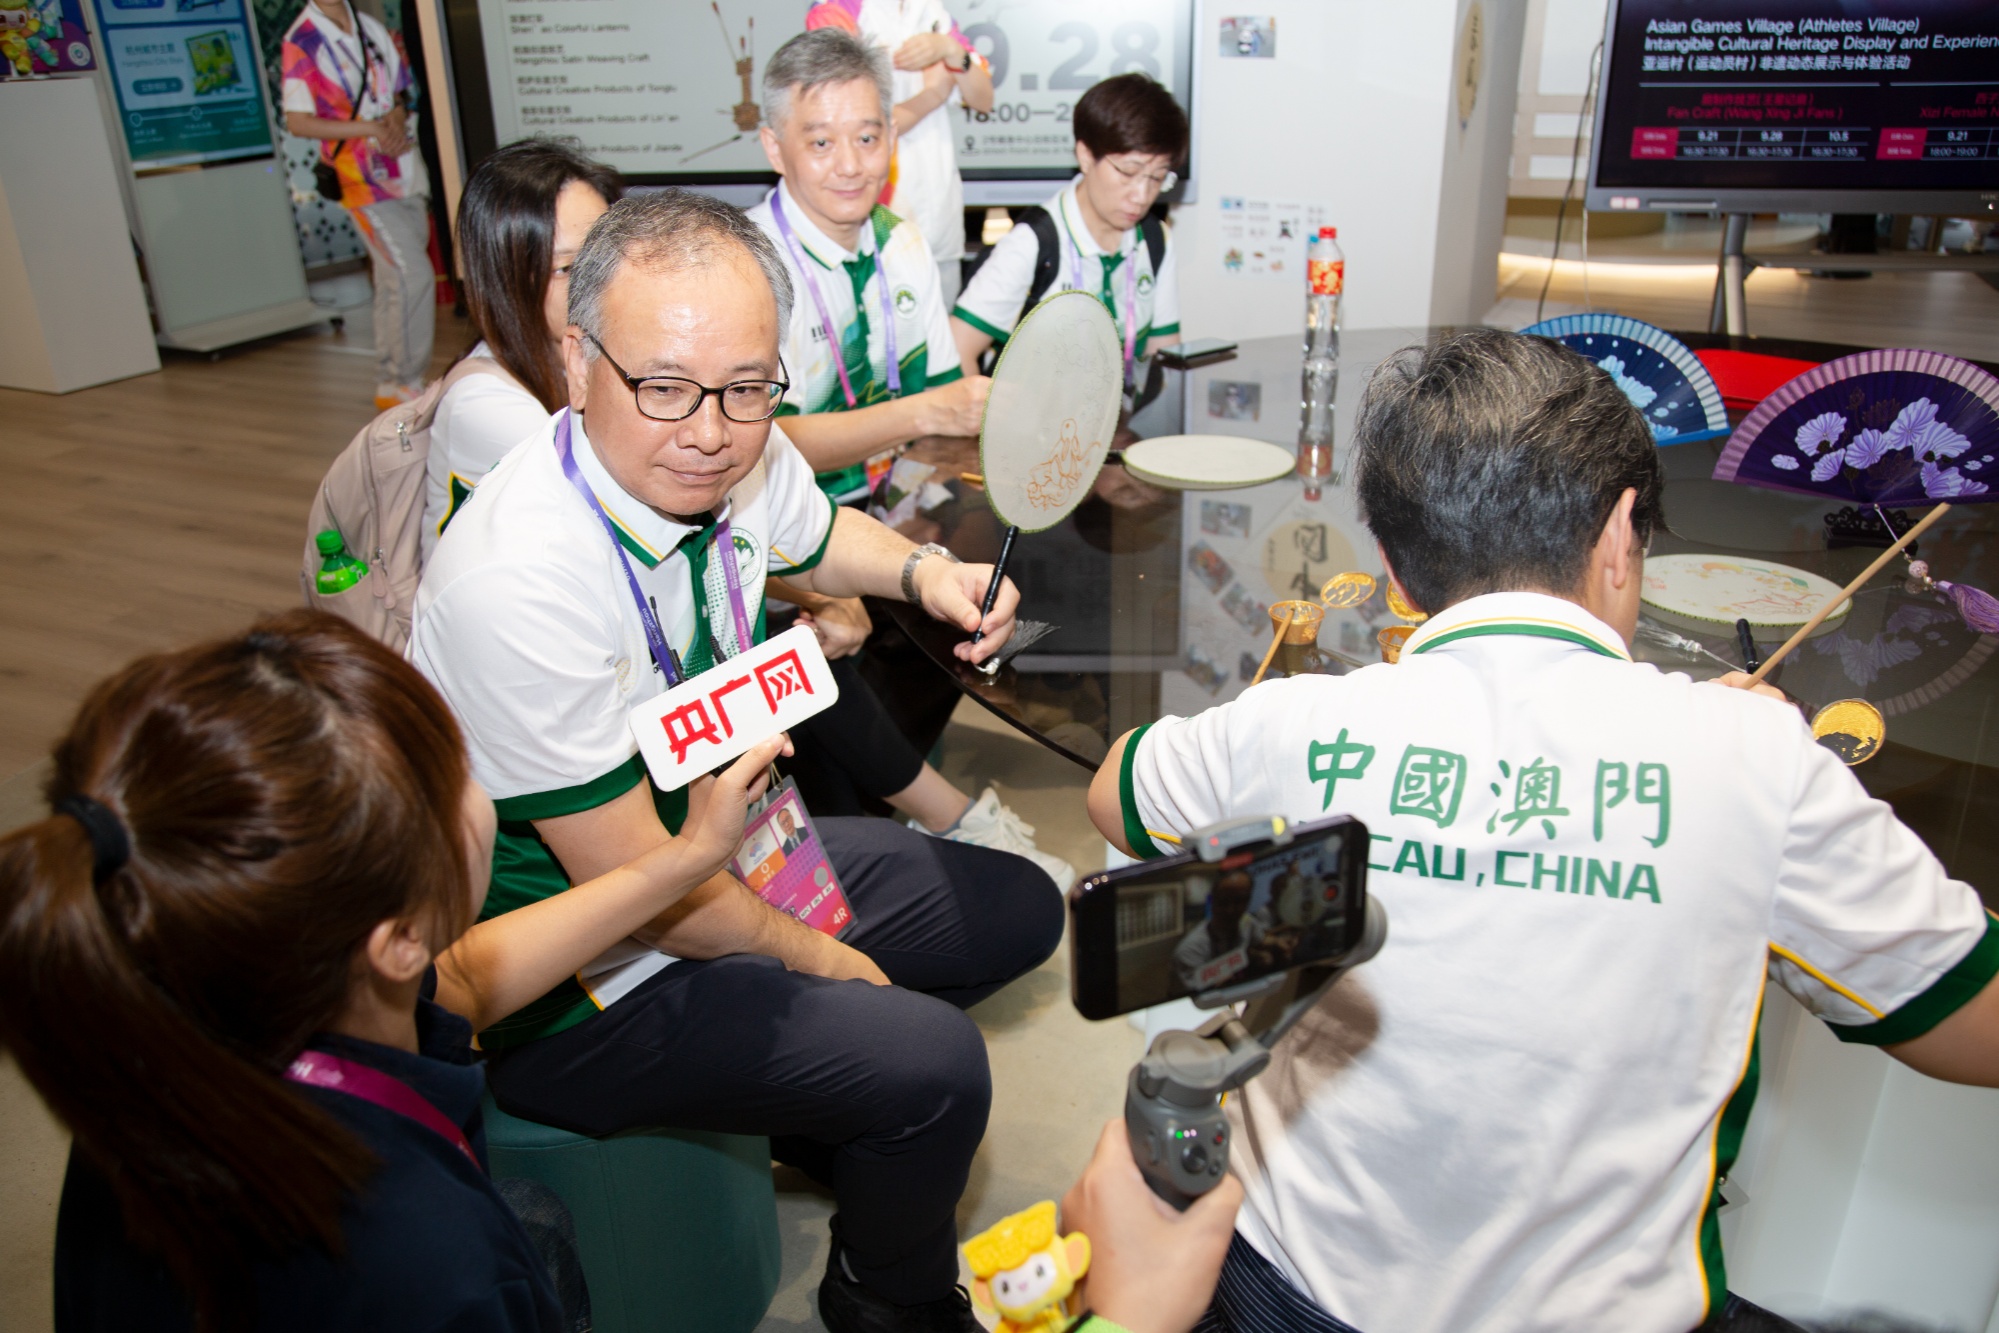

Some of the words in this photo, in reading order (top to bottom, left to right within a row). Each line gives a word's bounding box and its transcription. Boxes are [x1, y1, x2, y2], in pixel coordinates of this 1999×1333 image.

[1644, 36, 1714, 54] Intangible
[1718, 35, 1774, 51] Cultural
[1776, 35, 1839, 53] Heritage
[1843, 35, 1896, 52] Display
[1899, 35, 1930, 50] and
[1646, 18, 1687, 34] Asian
[1690, 18, 1743, 34] Games
[1747, 18, 1794, 36] Village
[1798, 18, 1863, 35] (Athletes
[1867, 17, 1920, 35] Village)
[660, 648, 815, 765] 央广网
[1308, 728, 1671, 850] 中國澳門
[1494, 849, 1662, 904] CHINA
[832, 906, 848, 925] 4R
